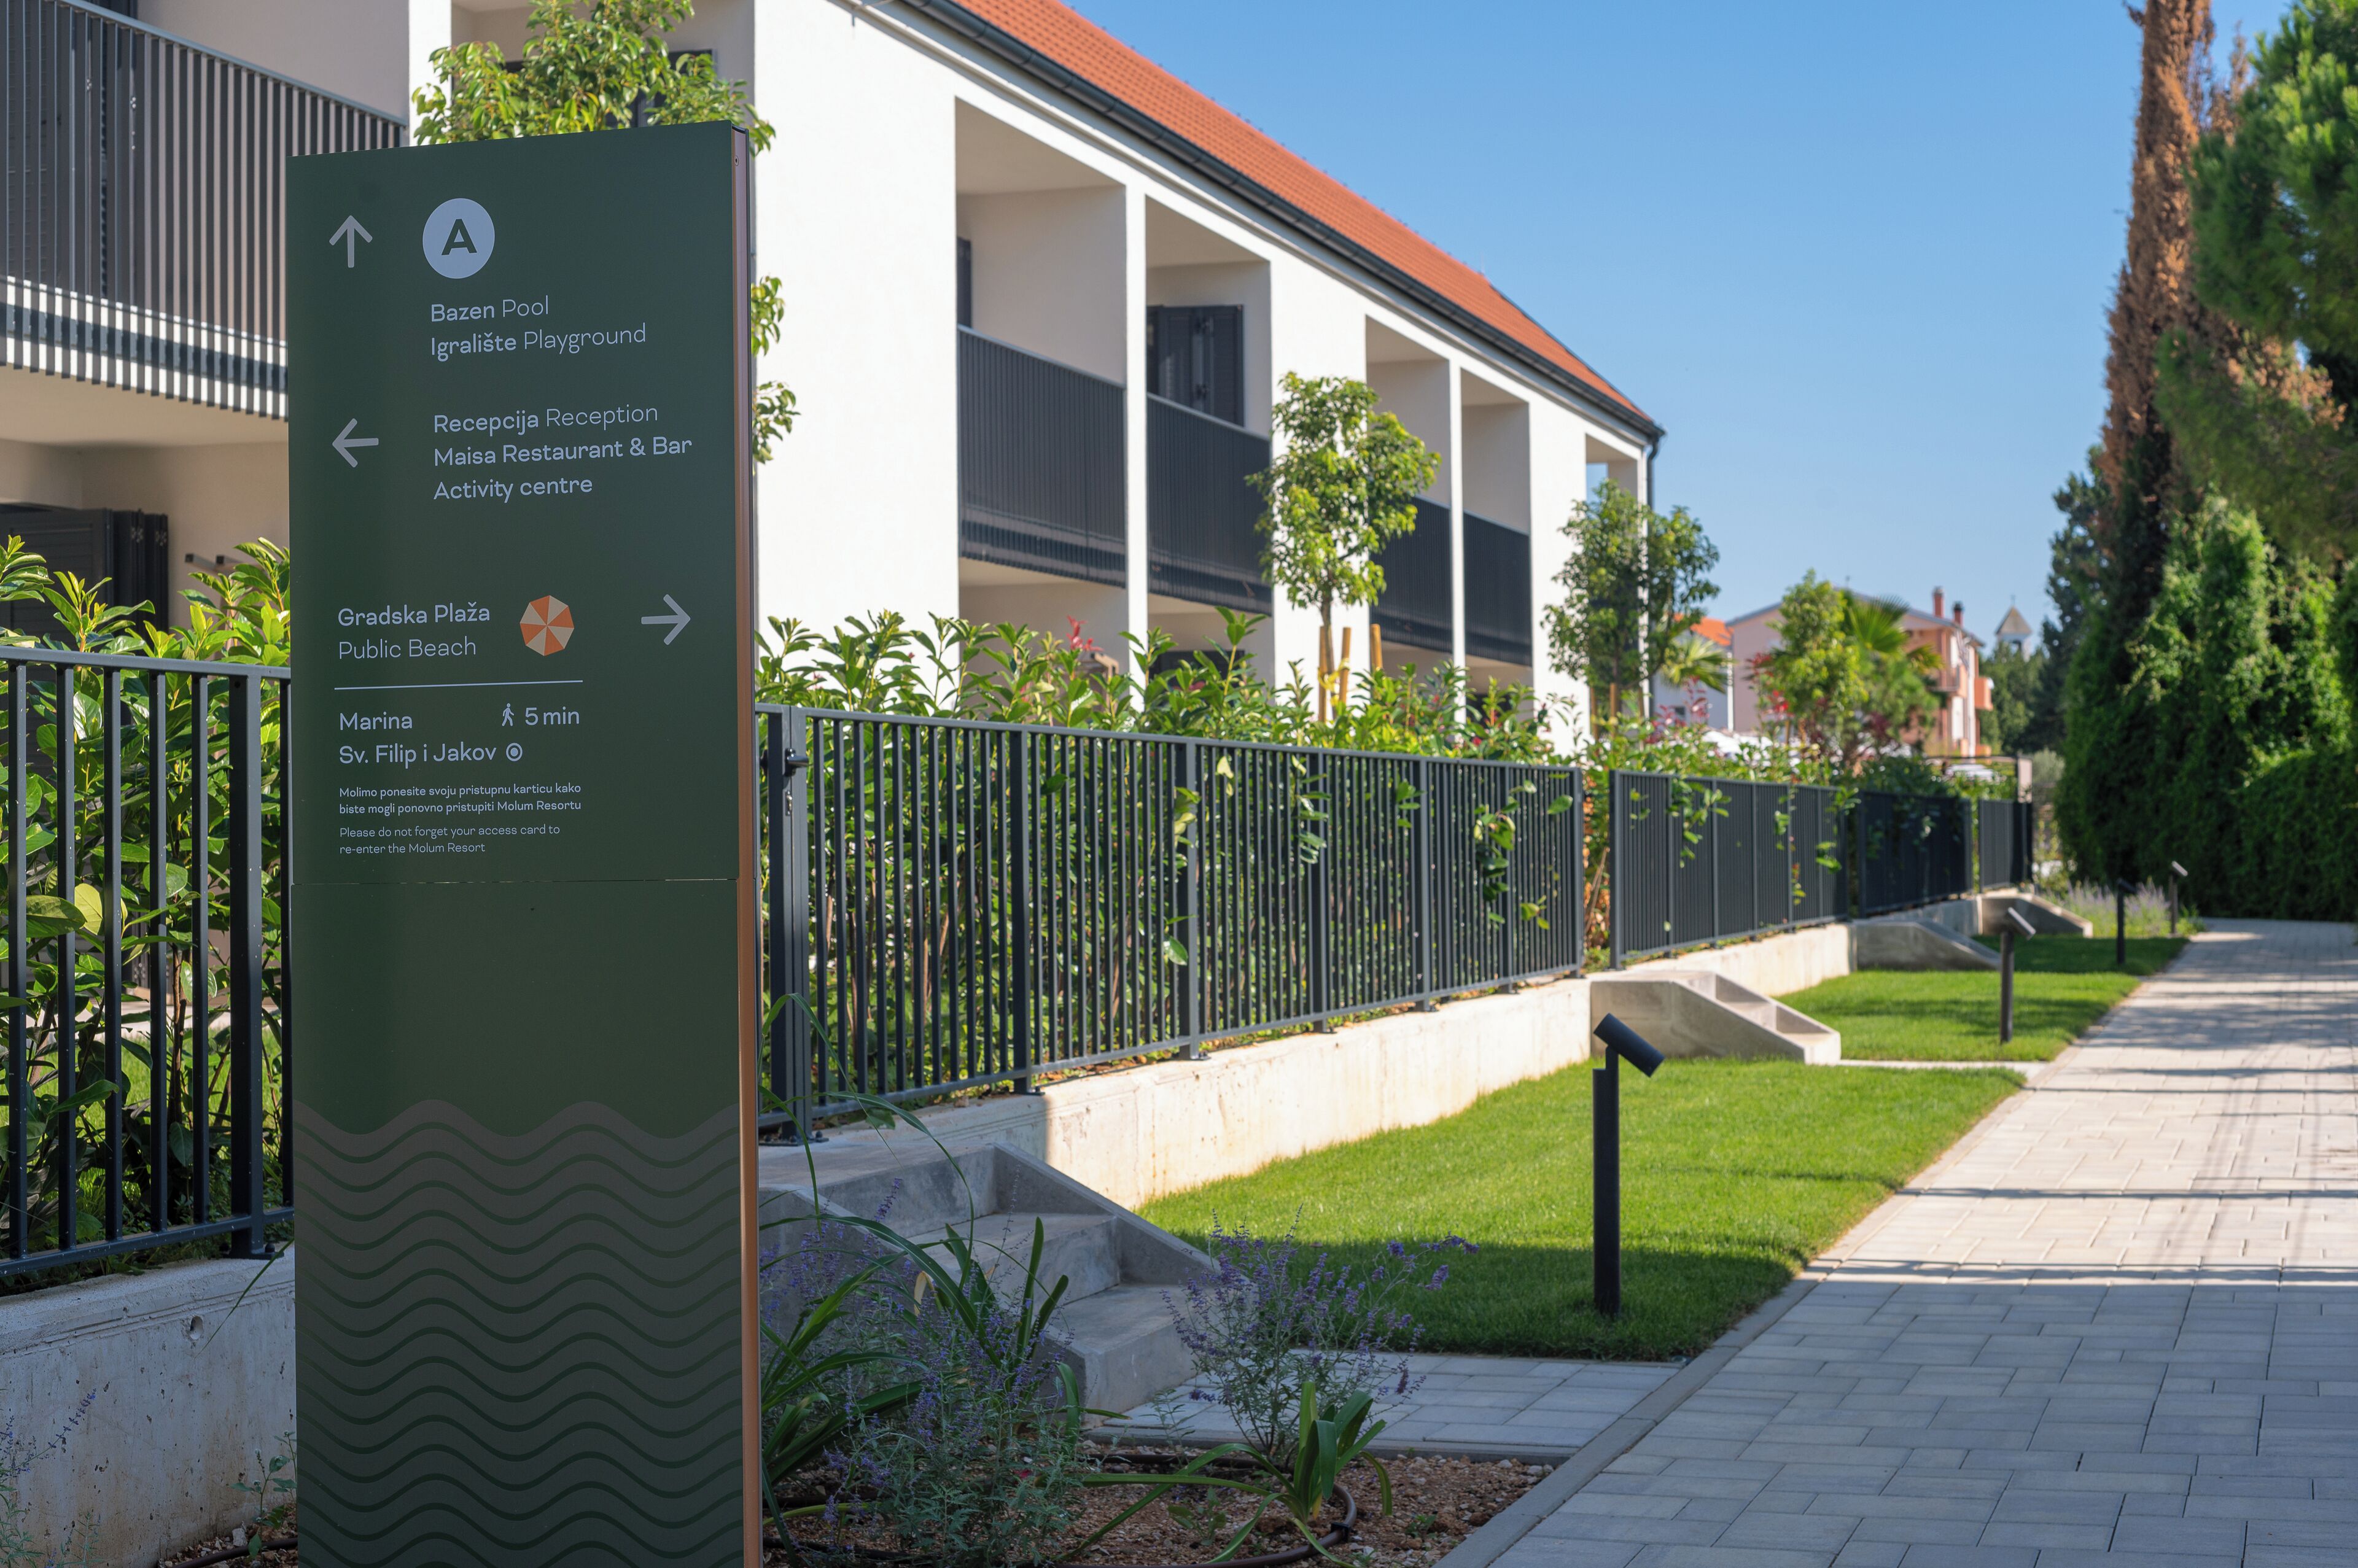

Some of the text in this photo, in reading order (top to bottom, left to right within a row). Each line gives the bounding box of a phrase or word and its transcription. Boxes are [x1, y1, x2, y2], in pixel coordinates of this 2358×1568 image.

[441, 219, 477, 255] A
[431, 295, 548, 322] Bazen Pool
[431, 322, 646, 362] Igralište Playground
[434, 403, 658, 437] Recepcija Reception
[434, 436, 693, 467] Maisa Restaurant & Bar
[433, 477, 593, 503] Activity centre
[338, 601, 490, 627] Gradska Plaža
[339, 635, 477, 659] Public Beach
[340, 711, 413, 731] Marina
[525, 706, 580, 726] 5 min
[339, 741, 497, 769] Sv. Filip i Jakov
[339, 782, 582, 800] Molimo ponesite svoju pristupnu karticu kako
[339, 800, 582, 817] biste mogli ponovno pristupiti Molum Resortu
[340, 823, 561, 840] Please do not forget your access card to
[340, 842, 486, 855] re-enter the Molum Resort
